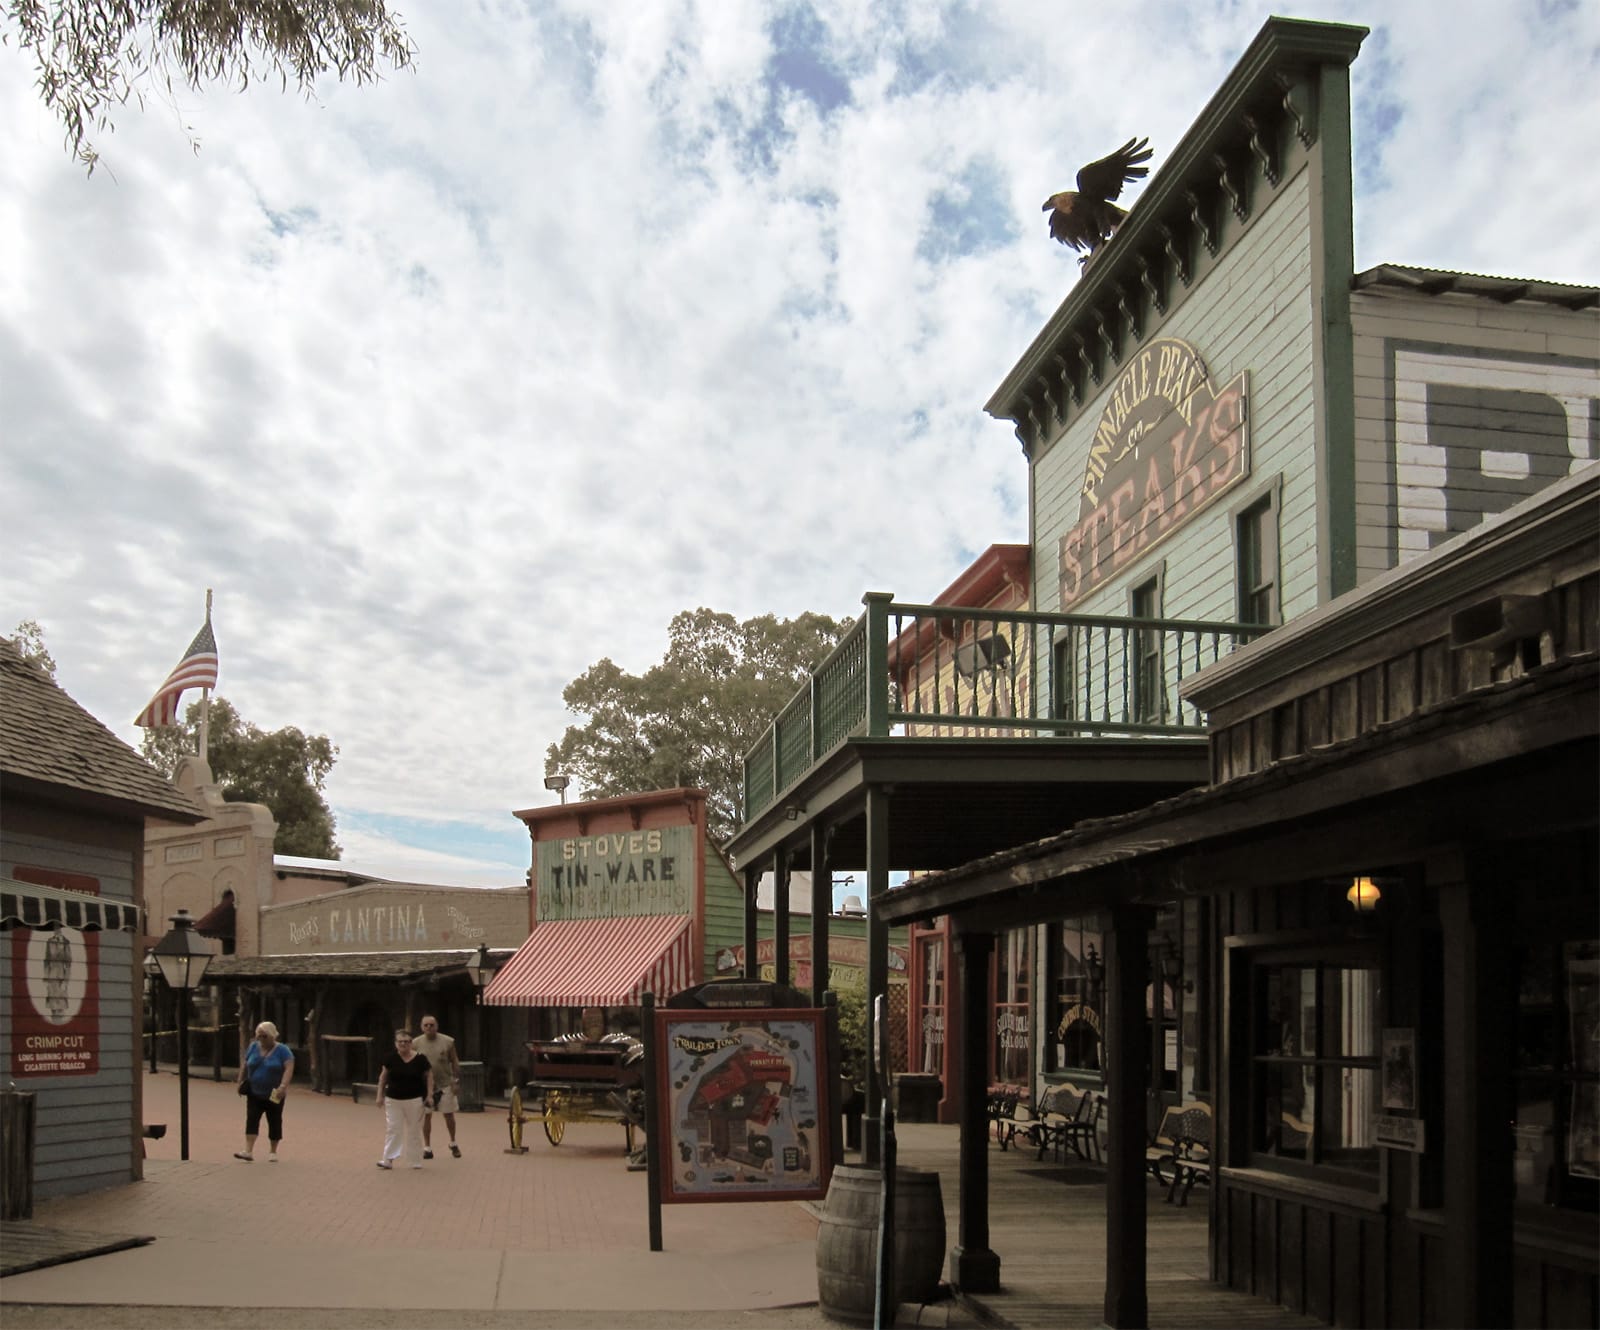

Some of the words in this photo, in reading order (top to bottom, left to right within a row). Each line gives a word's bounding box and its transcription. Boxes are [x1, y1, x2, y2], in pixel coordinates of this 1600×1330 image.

[1084, 352, 1151, 509] PINNACLE
[1154, 346, 1207, 428] PEAK
[1064, 391, 1239, 603] STEAKS
[563, 830, 662, 860] STOVES
[329, 904, 426, 944] CANTINA
[26, 1036, 62, 1048] CRIMP
[63, 1035, 85, 1048] CUT
[1001, 1033, 1029, 1049] SALOON
